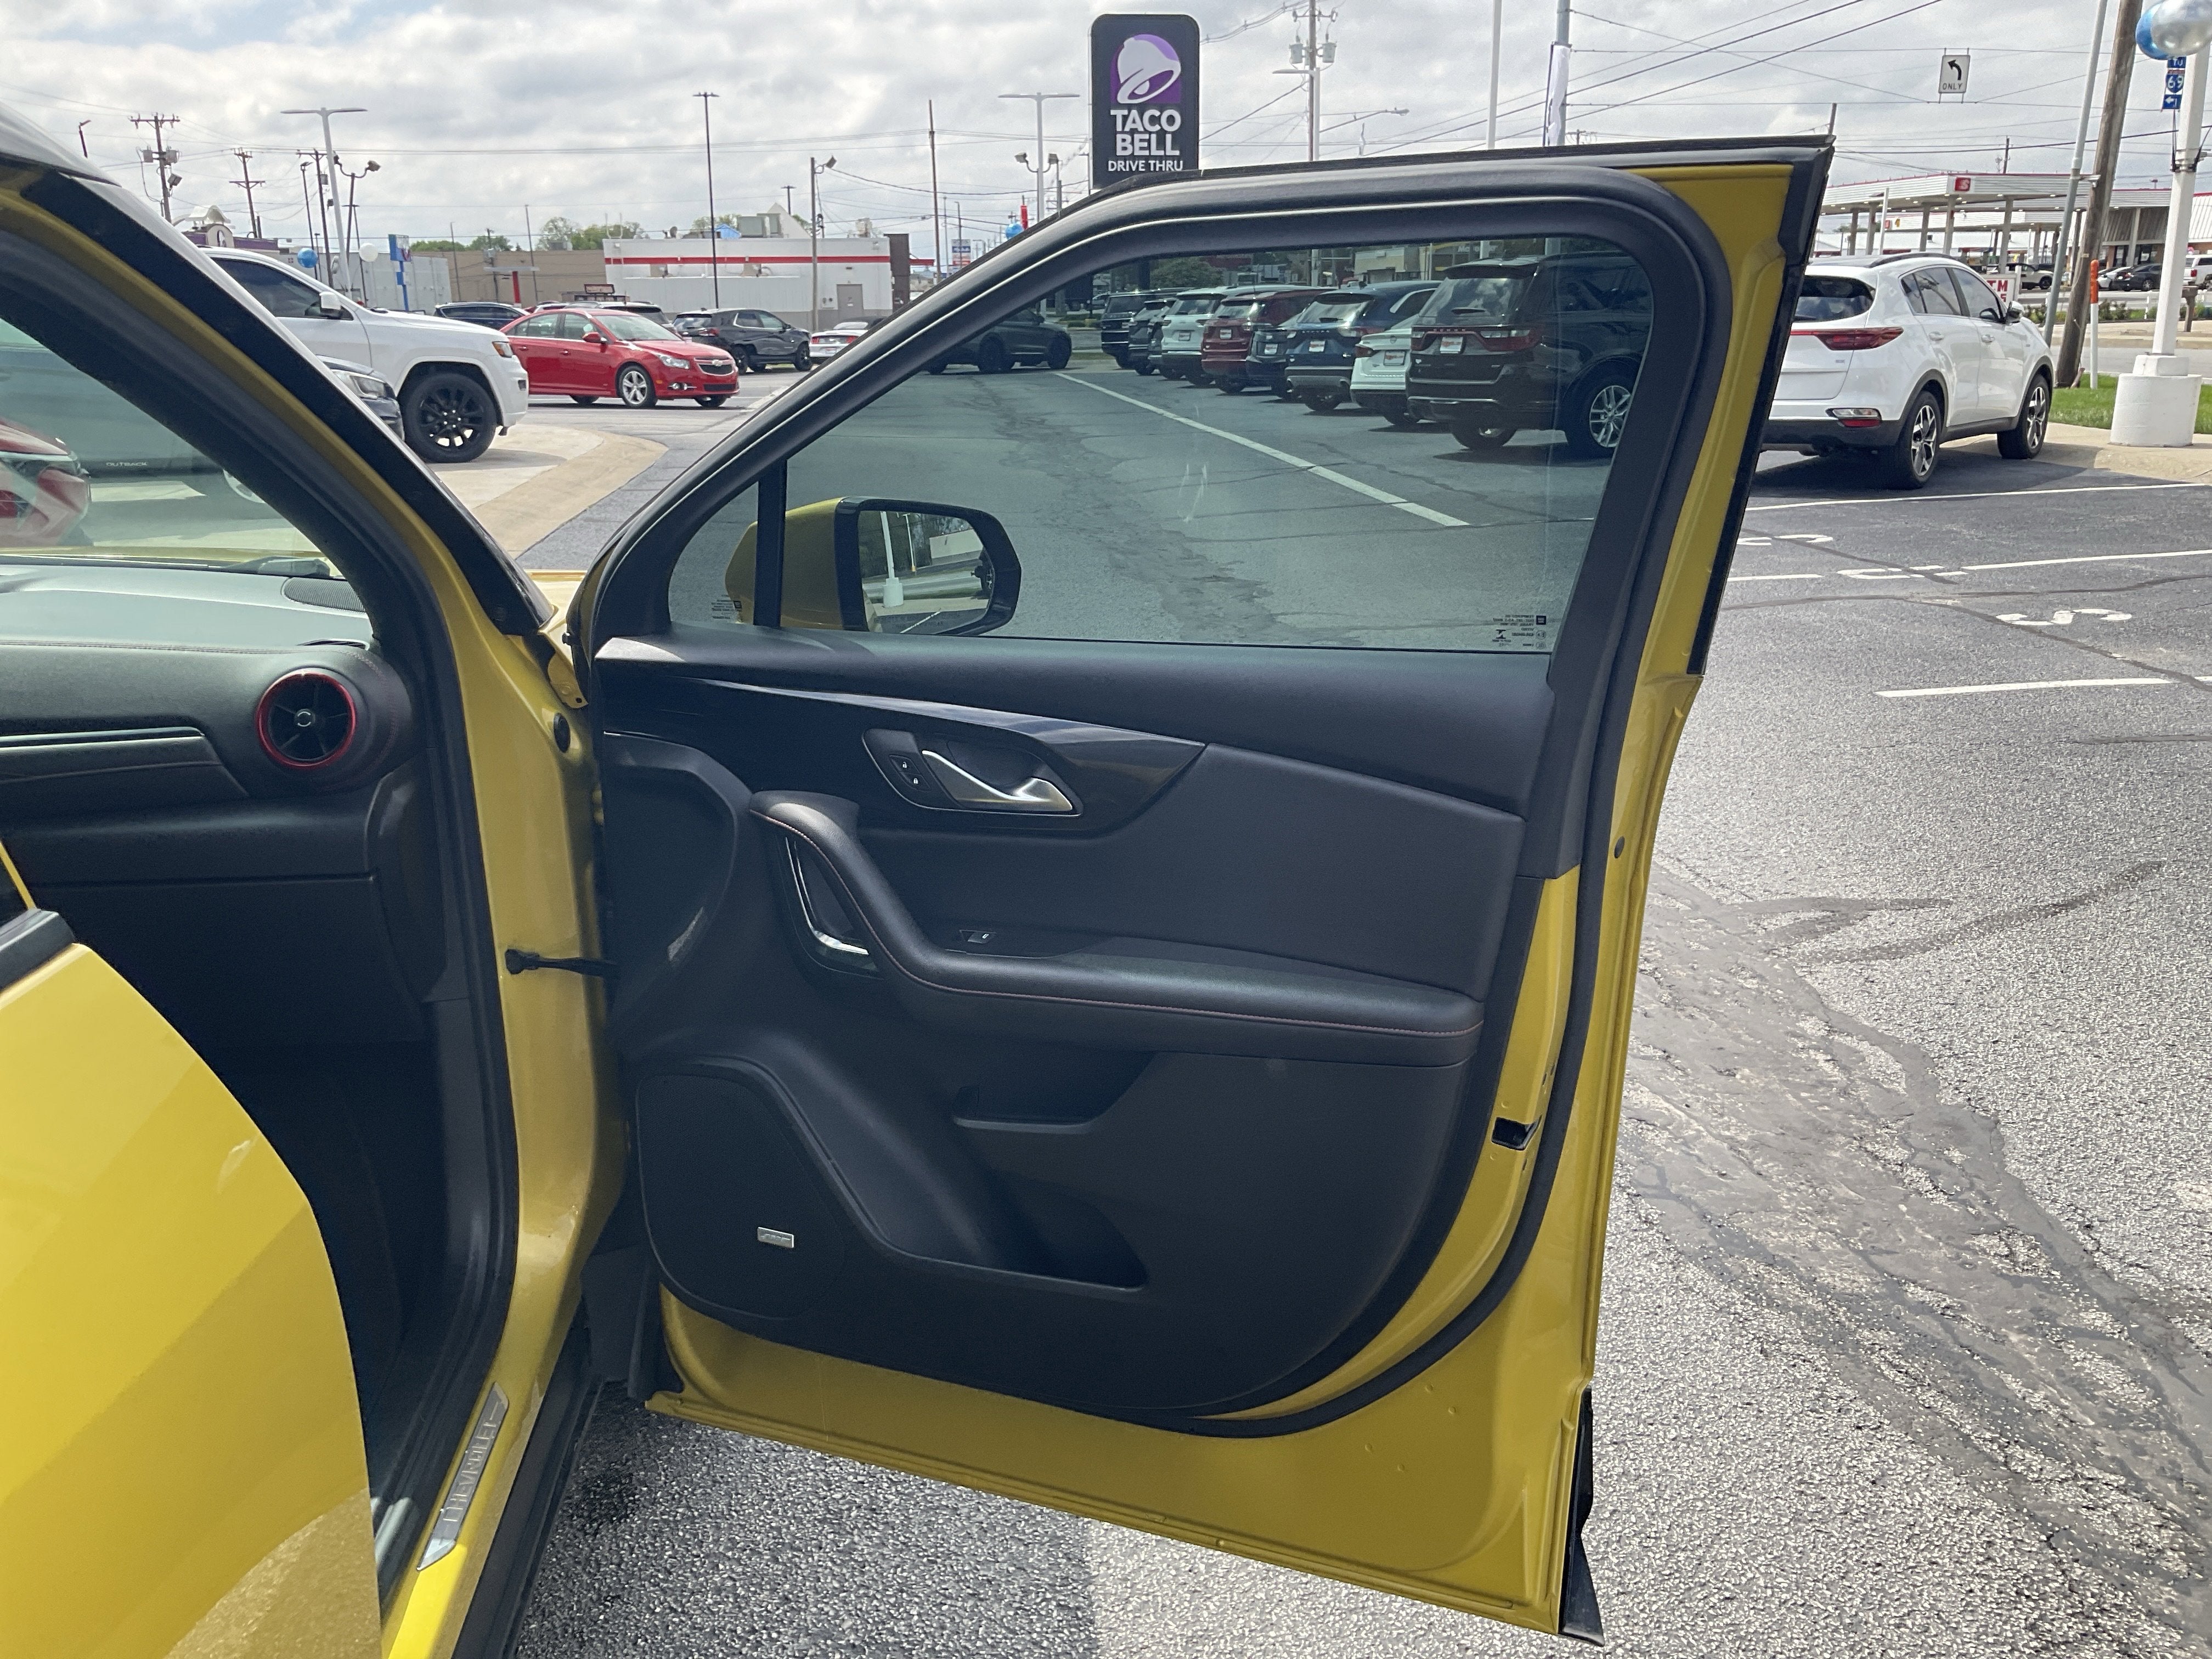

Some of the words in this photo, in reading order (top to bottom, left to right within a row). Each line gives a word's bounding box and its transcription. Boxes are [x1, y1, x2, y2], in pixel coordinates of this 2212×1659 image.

[2168, 75, 2184, 89] 69
[1110, 109, 1181, 132] TACO
[1116, 133, 1180, 156] BELL
[1108, 160, 1147, 172] DRIVE
[1148, 160, 1183, 171] THRU
